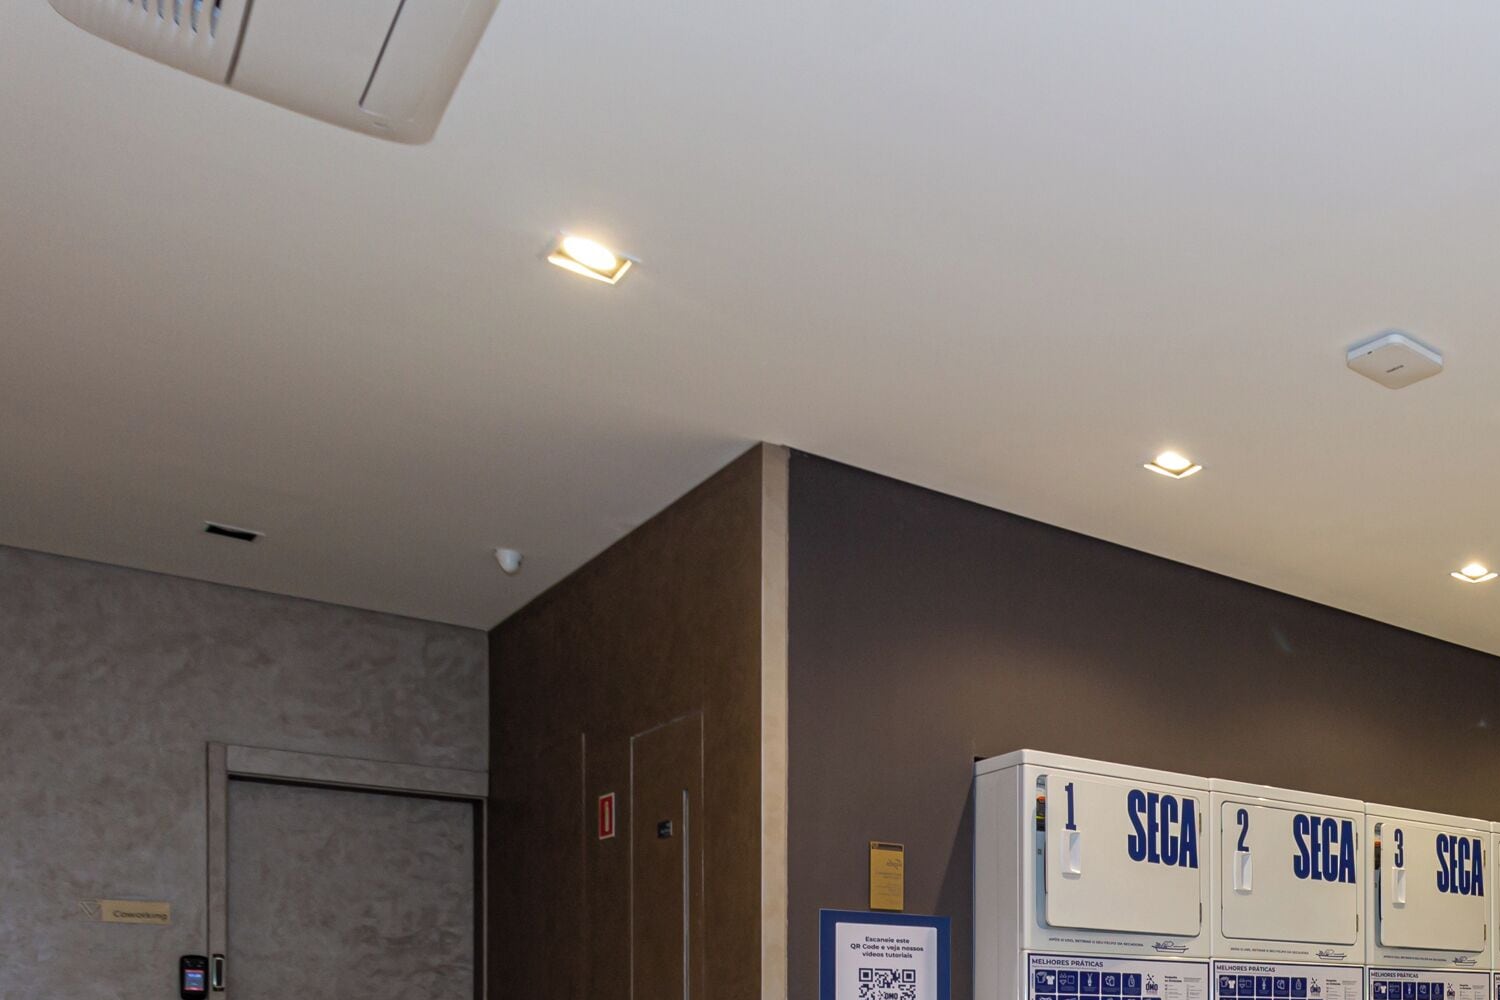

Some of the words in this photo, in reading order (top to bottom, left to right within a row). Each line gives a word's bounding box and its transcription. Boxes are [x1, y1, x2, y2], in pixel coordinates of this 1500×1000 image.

[1065, 782, 1077, 831] 1
[1127, 788, 1198, 869] SECA
[1236, 808, 1250, 852] 2
[1293, 813, 1356, 884] SECA
[1394, 828, 1404, 868] 3
[1436, 833, 1484, 897] SECA
[113, 910, 168, 921] Coworking
[1032, 958, 1069, 966] MELHORES
[1071, 958, 1103, 968] PRÁTICAS
